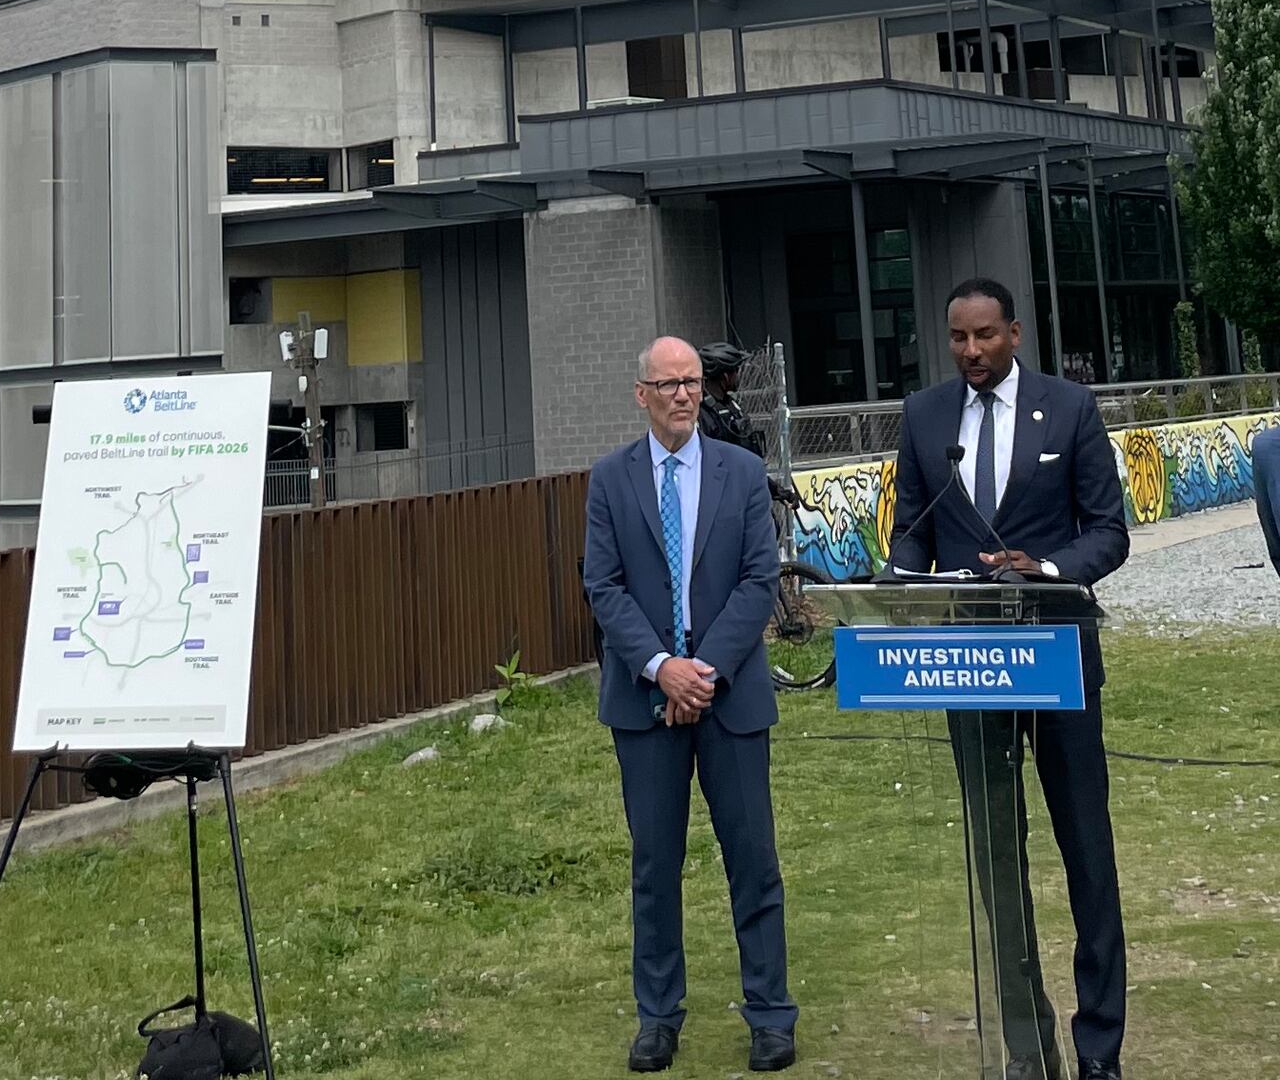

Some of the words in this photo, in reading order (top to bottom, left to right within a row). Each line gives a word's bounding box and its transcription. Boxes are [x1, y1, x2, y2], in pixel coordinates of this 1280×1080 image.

[149, 389, 188, 401] Atlanta
[154, 400, 197, 412] BeltLine
[90, 434, 113, 446] 17.9
[115, 432, 146, 444] miles
[148, 431, 160, 443] of
[162, 430, 226, 442] continuous,
[63, 450, 98, 463] paved
[100, 448, 145, 460] BeltLine
[147, 446, 169, 457] trail
[171, 445, 185, 458] by
[188, 444, 214, 455] FIFA
[216, 442, 249, 455] 2026
[878, 647, 1005, 665] INVESTING
[1011, 647, 1035, 665] IN
[903, 669, 1013, 687] AMERICA
[47, 718, 65, 726] MAP
[66, 717, 82, 726] KEY
